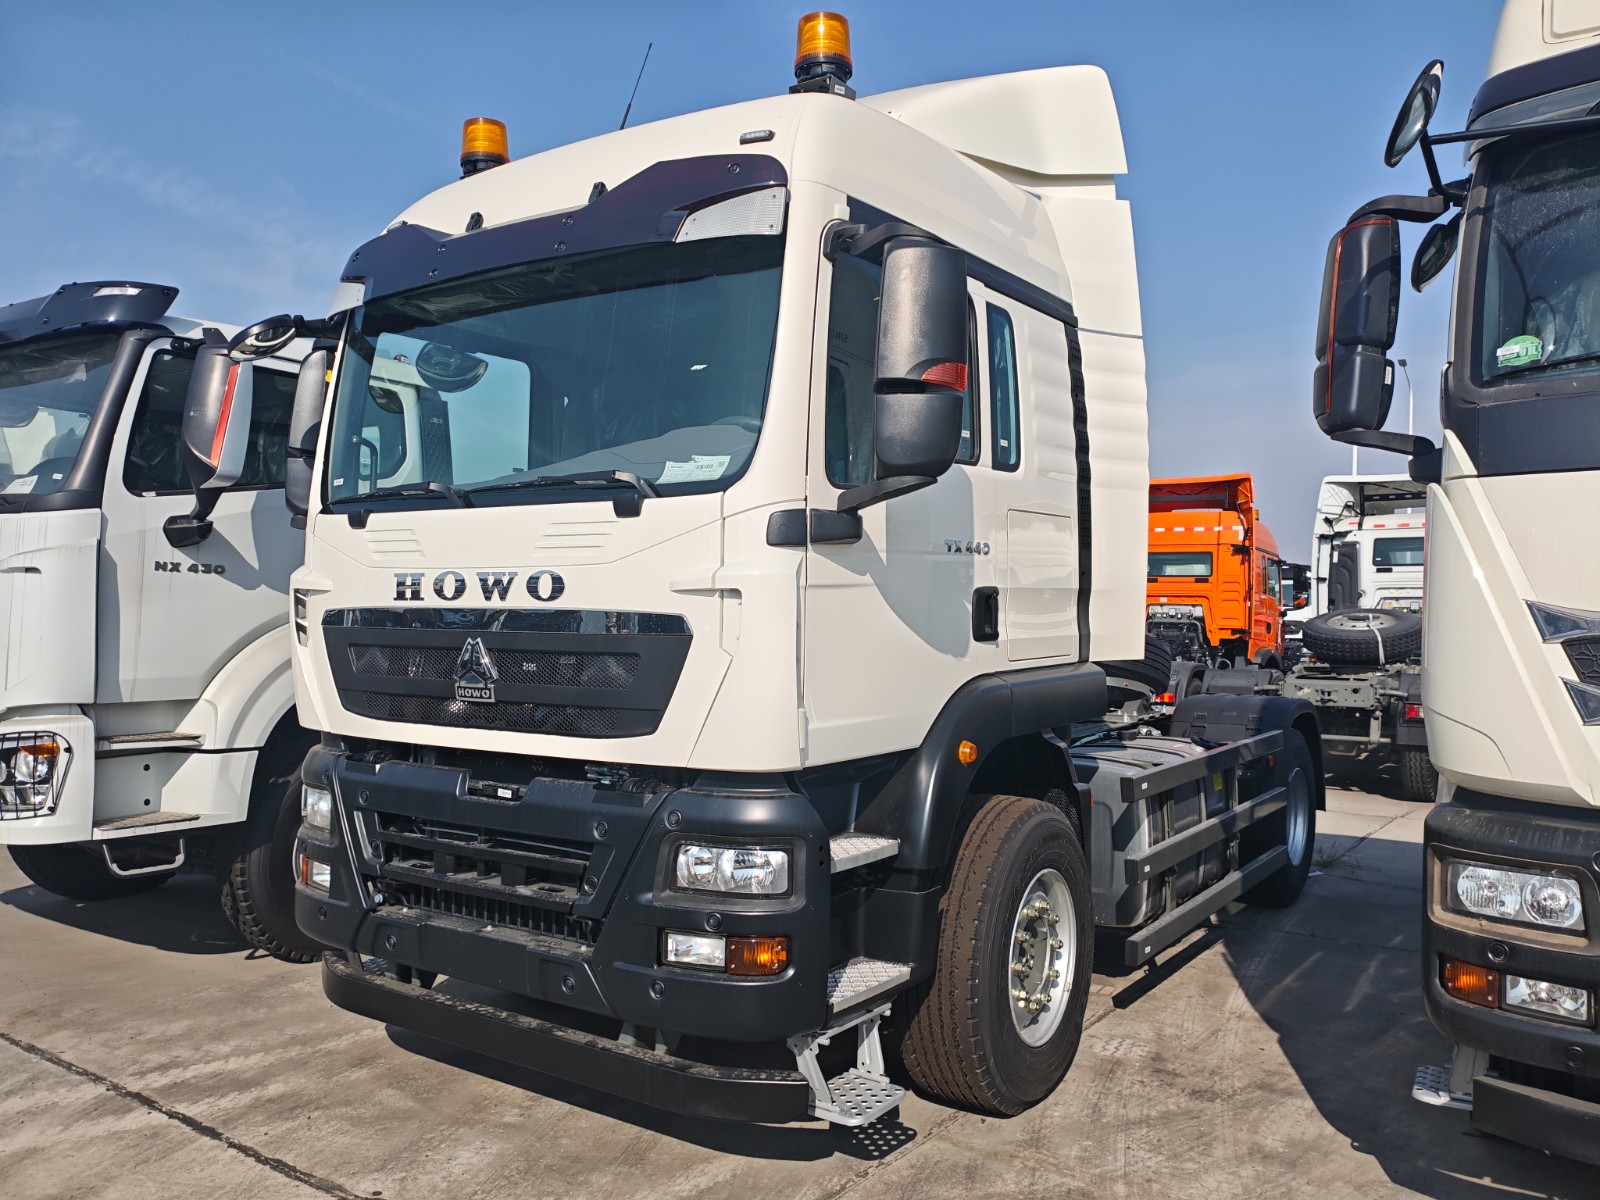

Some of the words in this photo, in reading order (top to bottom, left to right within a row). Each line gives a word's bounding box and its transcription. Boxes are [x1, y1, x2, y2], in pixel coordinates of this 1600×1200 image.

[944, 539, 962, 553] TX
[965, 541, 990, 556] 440
[154, 560, 181, 573] NX
[187, 563, 226, 575] 430
[393, 570, 566, 602] HOWO
[457, 687, 490, 698] HOWO
